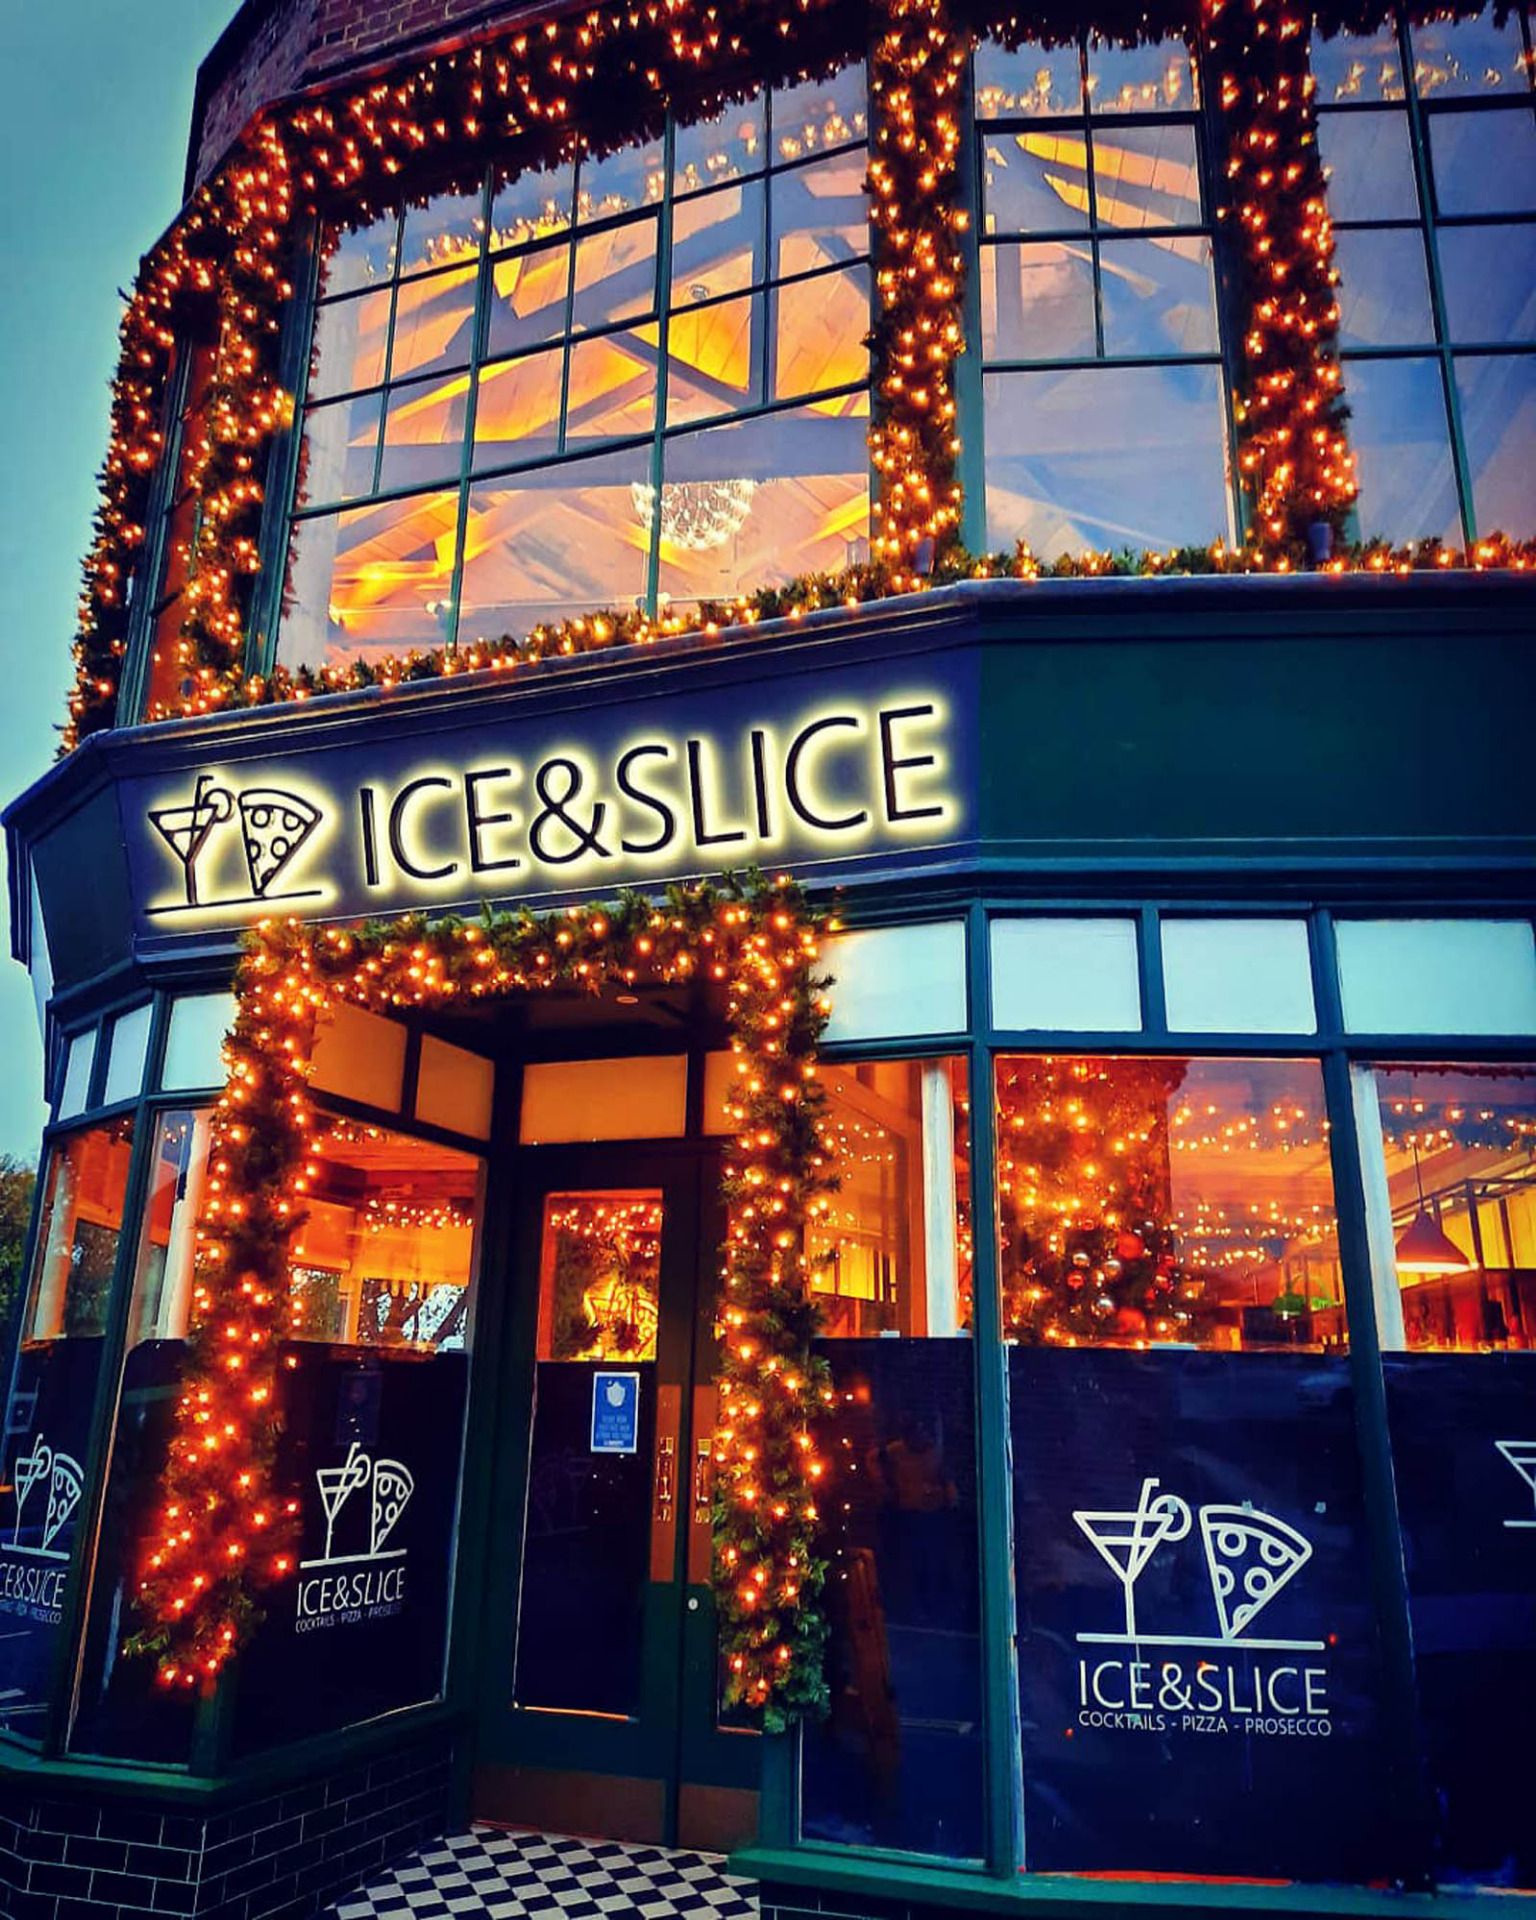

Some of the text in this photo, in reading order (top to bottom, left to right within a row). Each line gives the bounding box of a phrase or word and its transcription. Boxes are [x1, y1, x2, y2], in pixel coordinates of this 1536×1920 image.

[359, 704, 944, 887] ICE&SLICE
[296, 1566, 406, 1617] ICE&SLICE
[1078, 1660, 1330, 1715] ICE&SLICE
[1078, 1710, 1166, 1731] COCKTAILS
[1182, 1715, 1228, 1733] PIZZA
[1245, 1718, 1332, 1736] PROSECCO
